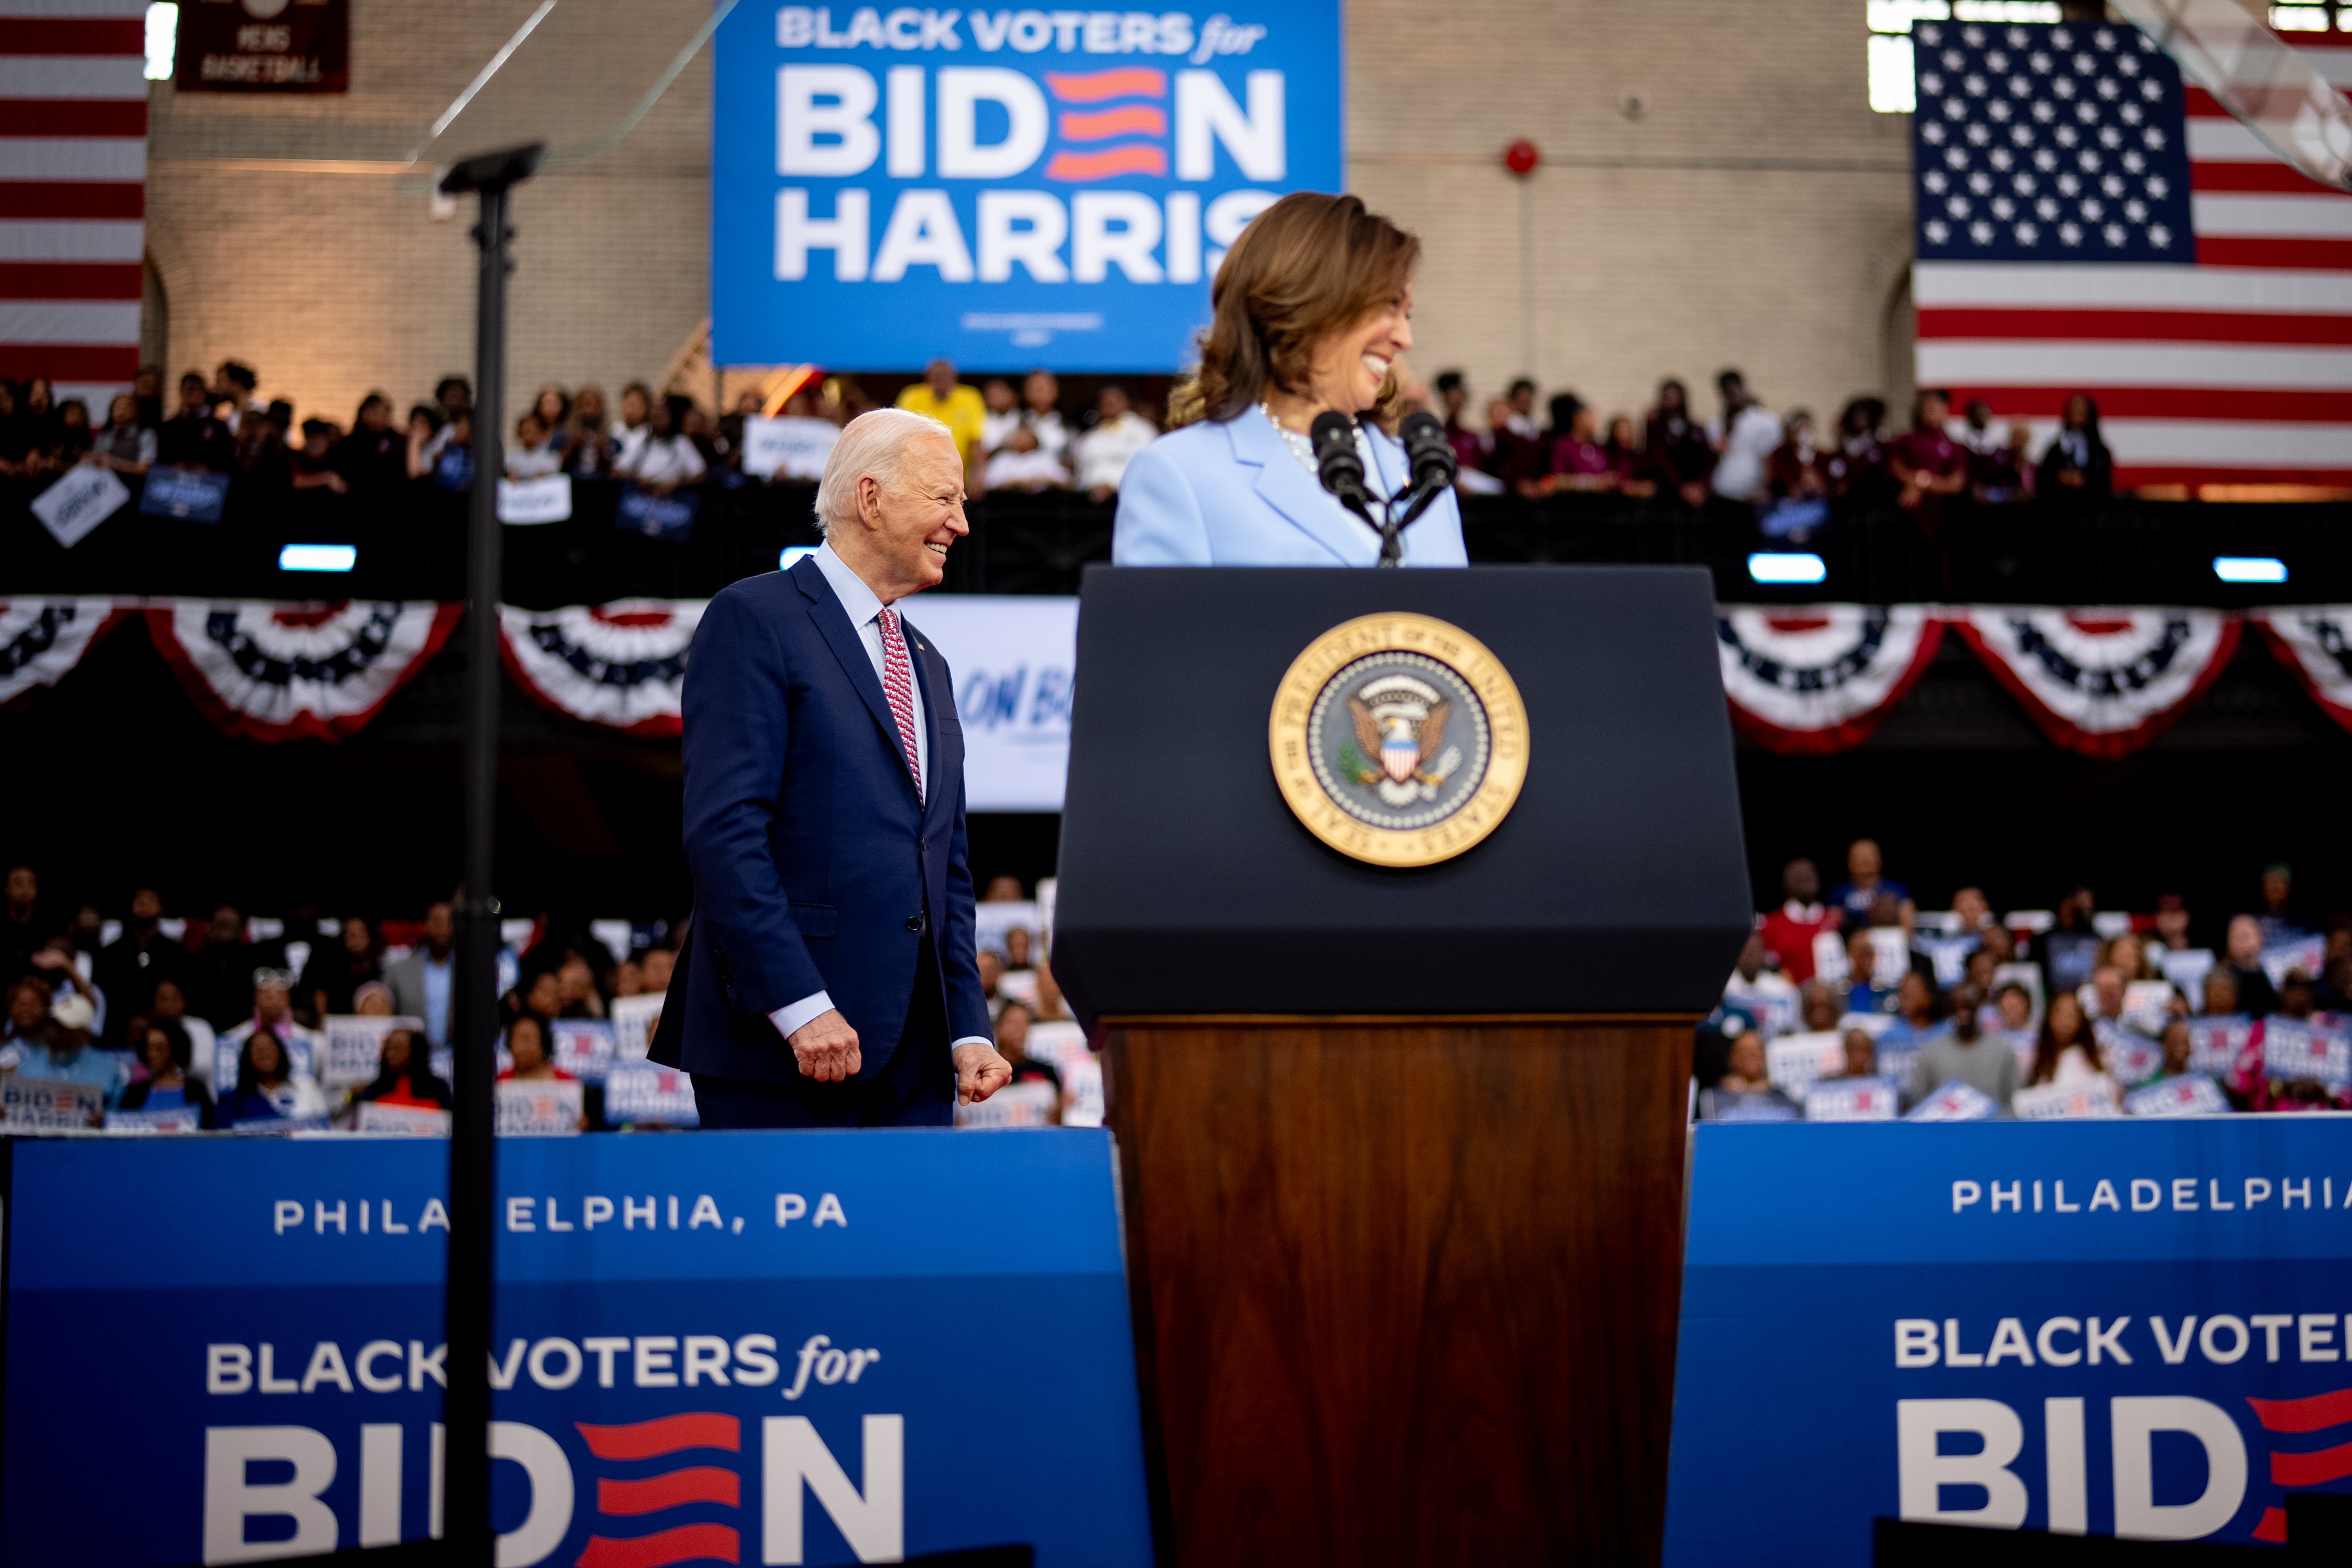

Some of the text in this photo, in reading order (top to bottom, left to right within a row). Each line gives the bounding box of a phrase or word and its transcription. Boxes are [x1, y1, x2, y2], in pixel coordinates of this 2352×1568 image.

[777, 7, 1266, 65] BLACK VOTERS for
[200, 54, 323, 83] BASKETBALL
[776, 64, 1286, 182] BIDEN
[274, 1193, 848, 1235] PHILAELPHIA, PA
[207, 1333, 881, 1401] BLACK VOTERS for
[1894, 1313, 2352, 1369] BLACK VOTE
[203, 1412, 905, 1568] BIDEN
